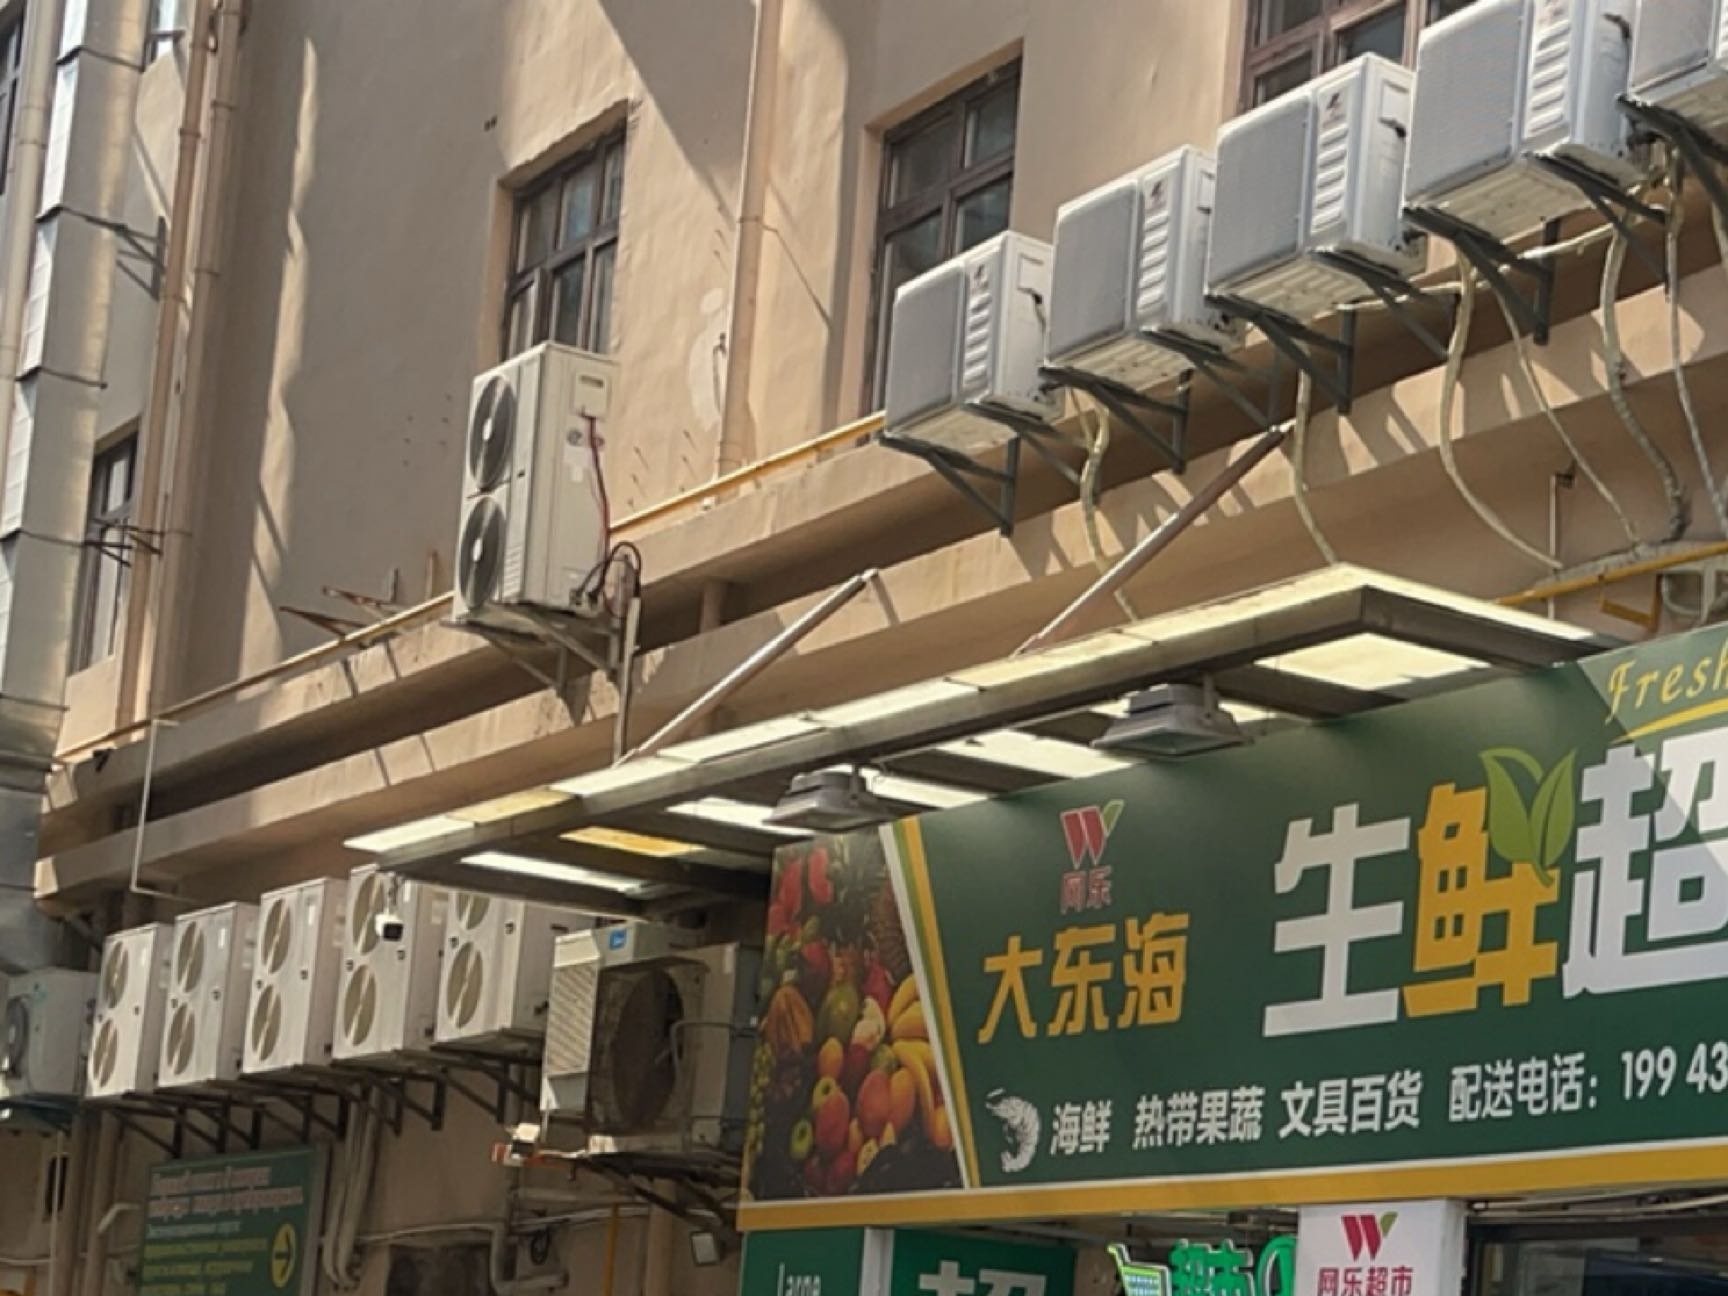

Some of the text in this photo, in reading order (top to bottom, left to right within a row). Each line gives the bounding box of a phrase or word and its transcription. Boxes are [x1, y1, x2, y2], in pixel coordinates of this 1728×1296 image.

[978, 913, 1189, 1044] 大东海
[1050, 1100, 1112, 1155] 海鲜
[1132, 1086, 1265, 1149] 热带果蔬
[1279, 1069, 1422, 1138] 文具百货
[1621, 1046, 1677, 1099] 199
